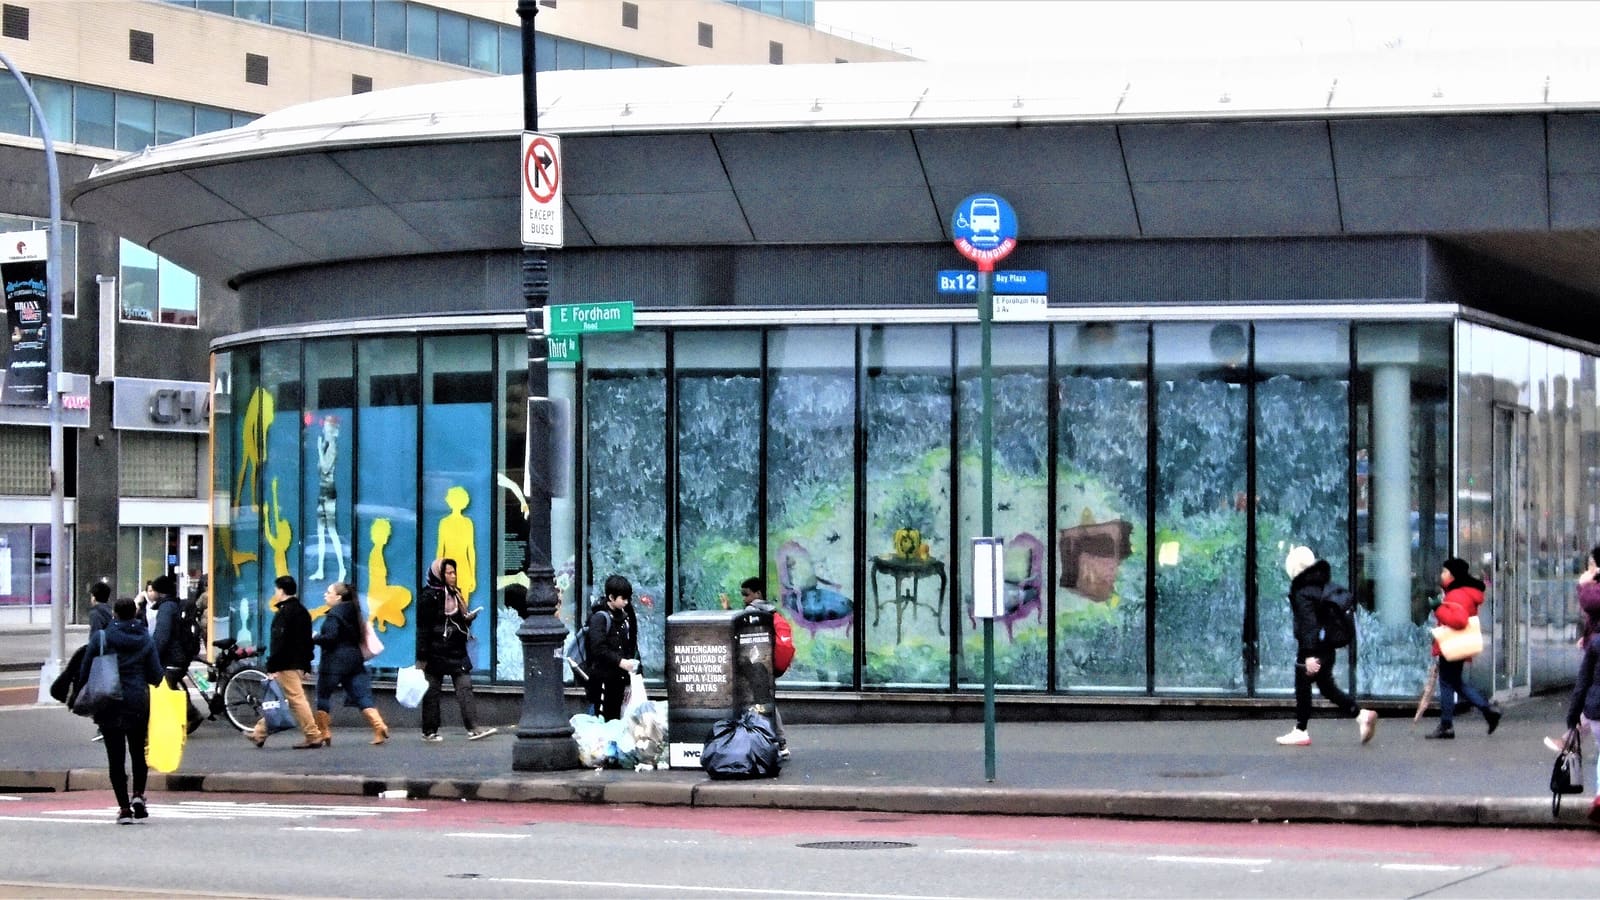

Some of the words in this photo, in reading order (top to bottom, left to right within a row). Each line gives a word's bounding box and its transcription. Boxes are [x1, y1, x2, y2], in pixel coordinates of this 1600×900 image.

[530, 208, 555, 220] EXCEPT
[531, 223, 554, 235] BUSES
[959, 239, 972, 252] NO
[971, 239, 1012, 259] STANDING
[941, 274, 976, 289] Bx12
[996, 274, 1008, 283] Bay
[1009, 274, 1027, 282] Plaza
[560, 308, 568, 322] E
[573, 307, 620, 322] Fordham
[583, 322, 598, 331] Road
[547, 337, 567, 358] Third
[674, 645, 727, 654] MANTENGAMOS
[675, 655, 680, 664] A
[681, 655, 690, 664] LA
[691, 655, 717, 664] CIUDAD
[717, 655, 727, 664] DE
[680, 664, 703, 673] NUEVA
[703, 664, 722, 673] YORK
[676, 674, 700, 683] LIMPIA
[700, 674, 706, 683] Y
[707, 674, 727, 683] LIBRE
[685, 683, 695, 692] DE
[695, 683, 718, 692] RATAS
[683, 750, 701, 758] NYC
